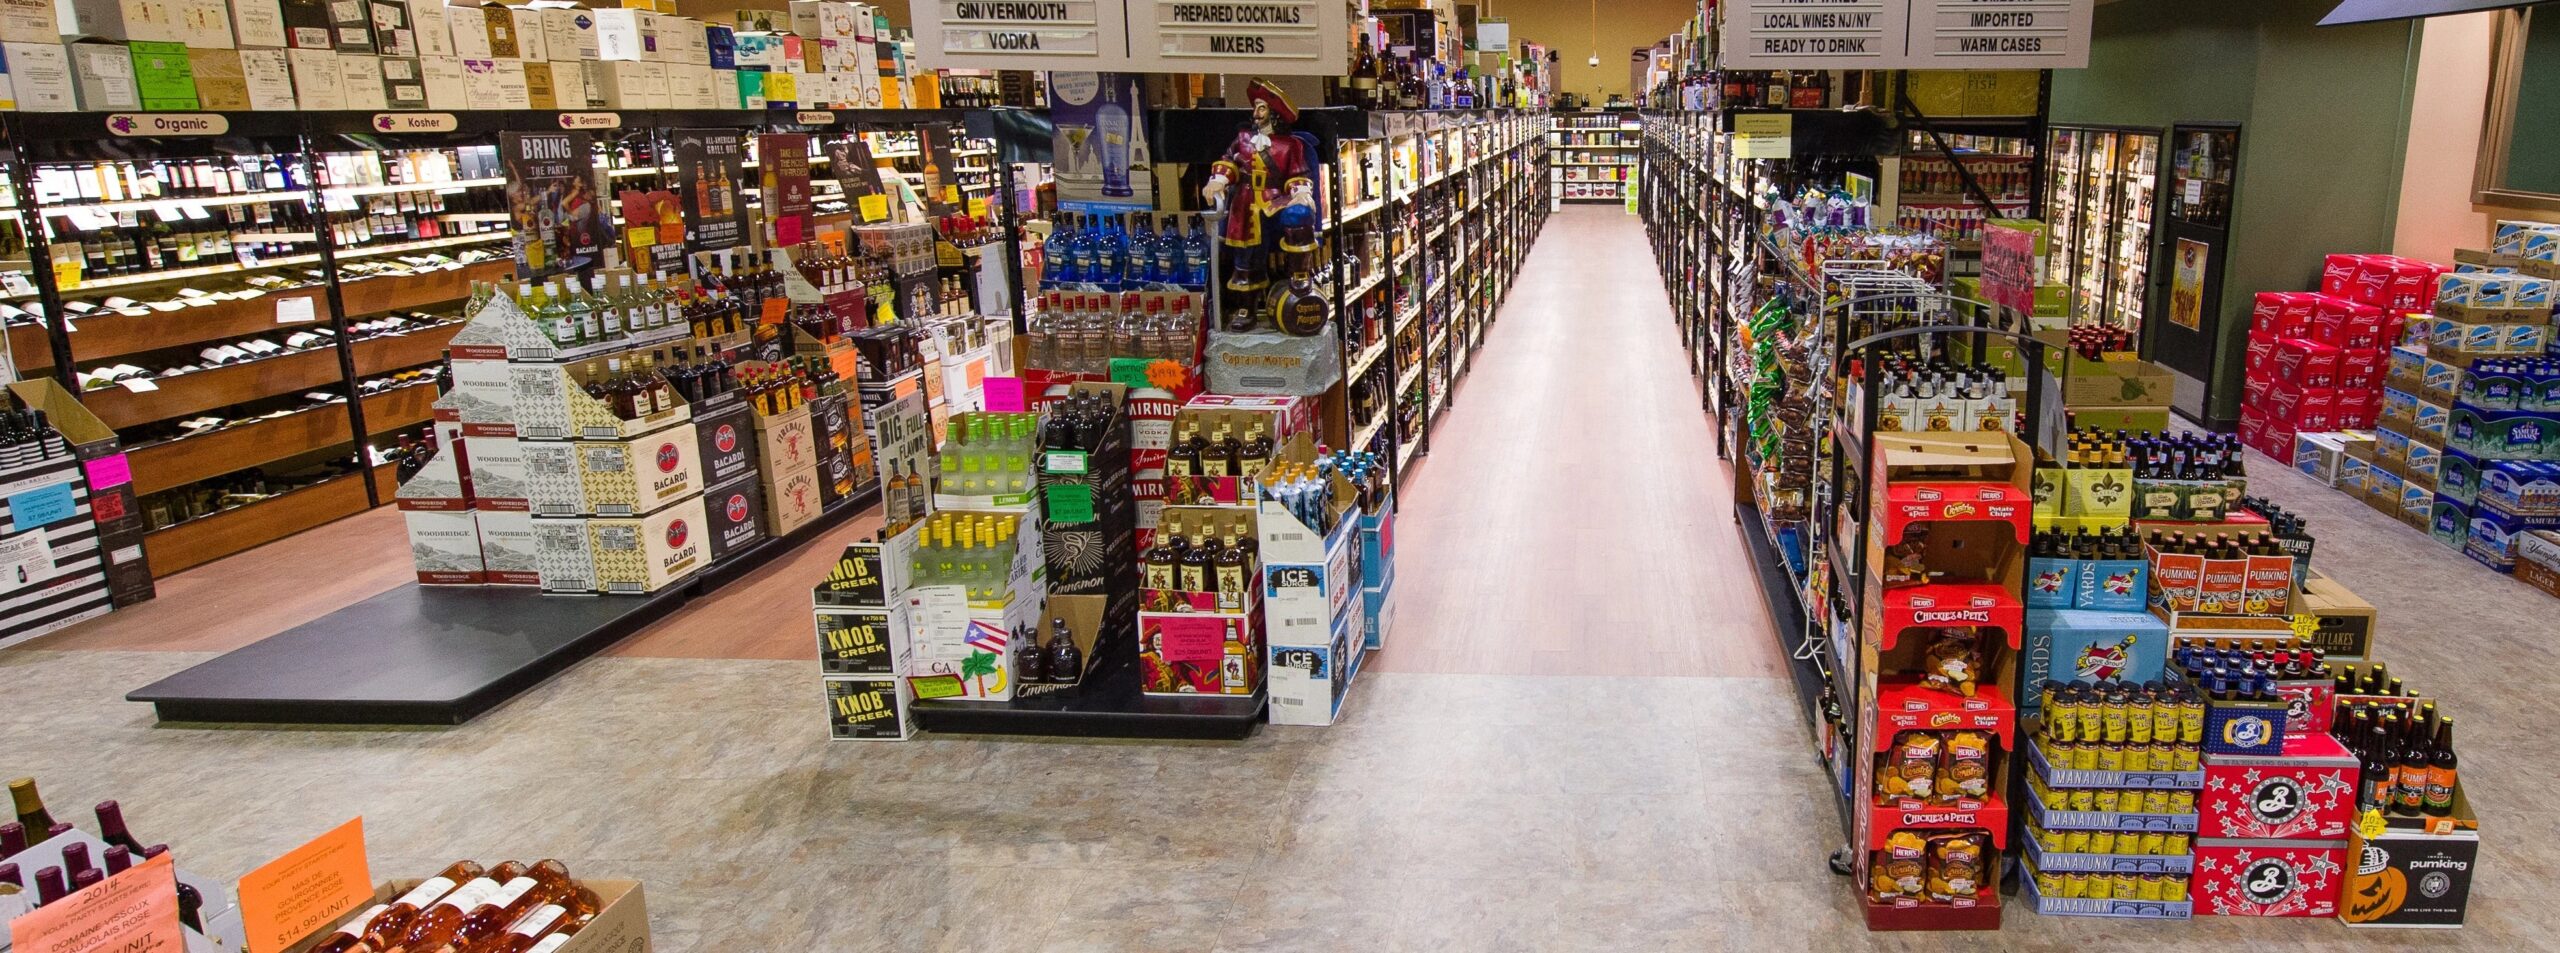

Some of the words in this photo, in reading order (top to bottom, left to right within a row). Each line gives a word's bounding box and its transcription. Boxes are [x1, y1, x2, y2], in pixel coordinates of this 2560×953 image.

[956, 2, 1067, 21] GIN/VERMOUTH
[1173, 5, 1232, 22] PREPARED
[1235, 6, 1300, 23] COCKTAILS
[1763, 14, 1799, 28] LOCAL
[1801, 14, 1835, 28] WINES
[1837, 14, 1871, 28] NJ/NY
[1970, 13, 2034, 28] IMPORTED
[988, 33, 1040, 51] VODKA
[1210, 36, 1265, 54] MIXERS
[1764, 39, 1805, 54] READY
[1809, 39, 1826, 53] TO
[1828, 38, 1866, 53] DRINK
[1960, 38, 1996, 53] WARM
[2001, 38, 2041, 53] CASES
[1545, 50, 1559, 62] 4
[1632, 50, 1649, 61] 5
[1967, 80, 1997, 90] FISH
[155, 118, 208, 132] Organic
[408, 117, 440, 127] Kosher
[579, 116, 612, 126] Germany
[705, 136, 736, 145] ALL-AMERICAN
[521, 138, 572, 160] BRING
[706, 145, 725, 155] GRILL
[725, 144, 737, 155] OUT
[530, 166, 545, 176] THE
[547, 165, 568, 176] PARTY
[2493, 236, 2510, 248] BLUE
[2522, 248, 2540, 259] BLUE
[2540, 242, 2558, 254] MOON
[2438, 290, 2453, 302] BLUE
[2453, 284, 2470, 295] MOON
[2430, 334, 2445, 345] BLUE
[2444, 329, 2462, 341] MOON
[1222, 352, 1260, 367] Captain
[1263, 354, 1302, 368] Morgan
[2423, 374, 2437, 386] BLUE
[2437, 371, 2456, 382] MOON
[1128, 402, 1184, 417] MIRNOF
[905, 413, 924, 436] FULL
[2415, 416, 2429, 427] BLUE
[2429, 414, 2447, 426] MOON
[776, 421, 806, 444] FIREBALL
[2512, 426, 2540, 436] SAMUEL
[2513, 432, 2538, 441] ADAMS
[713, 447, 745, 470] BACARDÍ
[2406, 456, 2422, 467] BLUE
[2421, 456, 2439, 466] MOON
[2353, 467, 2368, 475] MOON
[653, 467, 688, 492] BACARDÍ
[783, 473, 812, 498] FIREBALL
[999, 496, 1020, 504] LEMON
[2400, 498, 2416, 508] BLUE
[2415, 497, 2432, 507] MOON
[2524, 515, 2555, 525] SAMUEL
[723, 517, 755, 540] BACARDÍ
[2279, 538, 2292, 549] REAT
[2291, 538, 2311, 550] LAKES
[663, 542, 697, 568] BACARDÍ
[1280, 569, 1309, 583] ICE
[2159, 568, 2197, 580] PUMKING
[2205, 573, 2242, 584] PUMKING
[2249, 570, 2288, 581] PUMKING
[2529, 570, 2555, 589] LAGER
[830, 576, 879, 591] CREEK
[1047, 576, 1105, 596] Cinnamon
[2080, 560, 2096, 609] YARDS
[2295, 624, 2312, 635] OFF
[827, 624, 877, 651] KNOB
[2327, 631, 2355, 646] LAKES
[838, 643, 886, 658] CREEK
[1284, 651, 1313, 665] ICE
[2028, 634, 2051, 704] YARDS
[836, 690, 885, 717] KNOB
[847, 708, 894, 724] CREEK
[2056, 770, 2122, 785] MANAYUNK
[2326, 778, 2338, 789] IPA
[2050, 814, 2117, 828] MANAYUNK
[2045, 856, 2110, 870] MANAYUNK
[2315, 859, 2327, 870] IPA
[2409, 859, 2467, 872] pumking
[261, 879, 281, 892] YOUR
[281, 868, 304, 881] PARTY
[304, 854, 328, 870] STARTS
[291, 877, 311, 891] MAS
[311, 870, 323, 882] DE
[83, 878, 121, 905] 2014
[277, 870, 340, 910] GOURGONNIER
[273, 892, 321, 922] PROVENCE
[321, 878, 344, 896] ROSE
[2045, 900, 2110, 913] MANAYUNK
[42, 920, 69, 937] YOUR
[70, 908, 97, 925] PARTY
[98, 892, 129, 911] STARTS
[122, 909, 151, 930] ROSE
[277, 894, 352, 946] $14.99/UNIT
[51, 923, 101, 953] DOMAINE
[103, 899, 151, 926] VISSOUX
